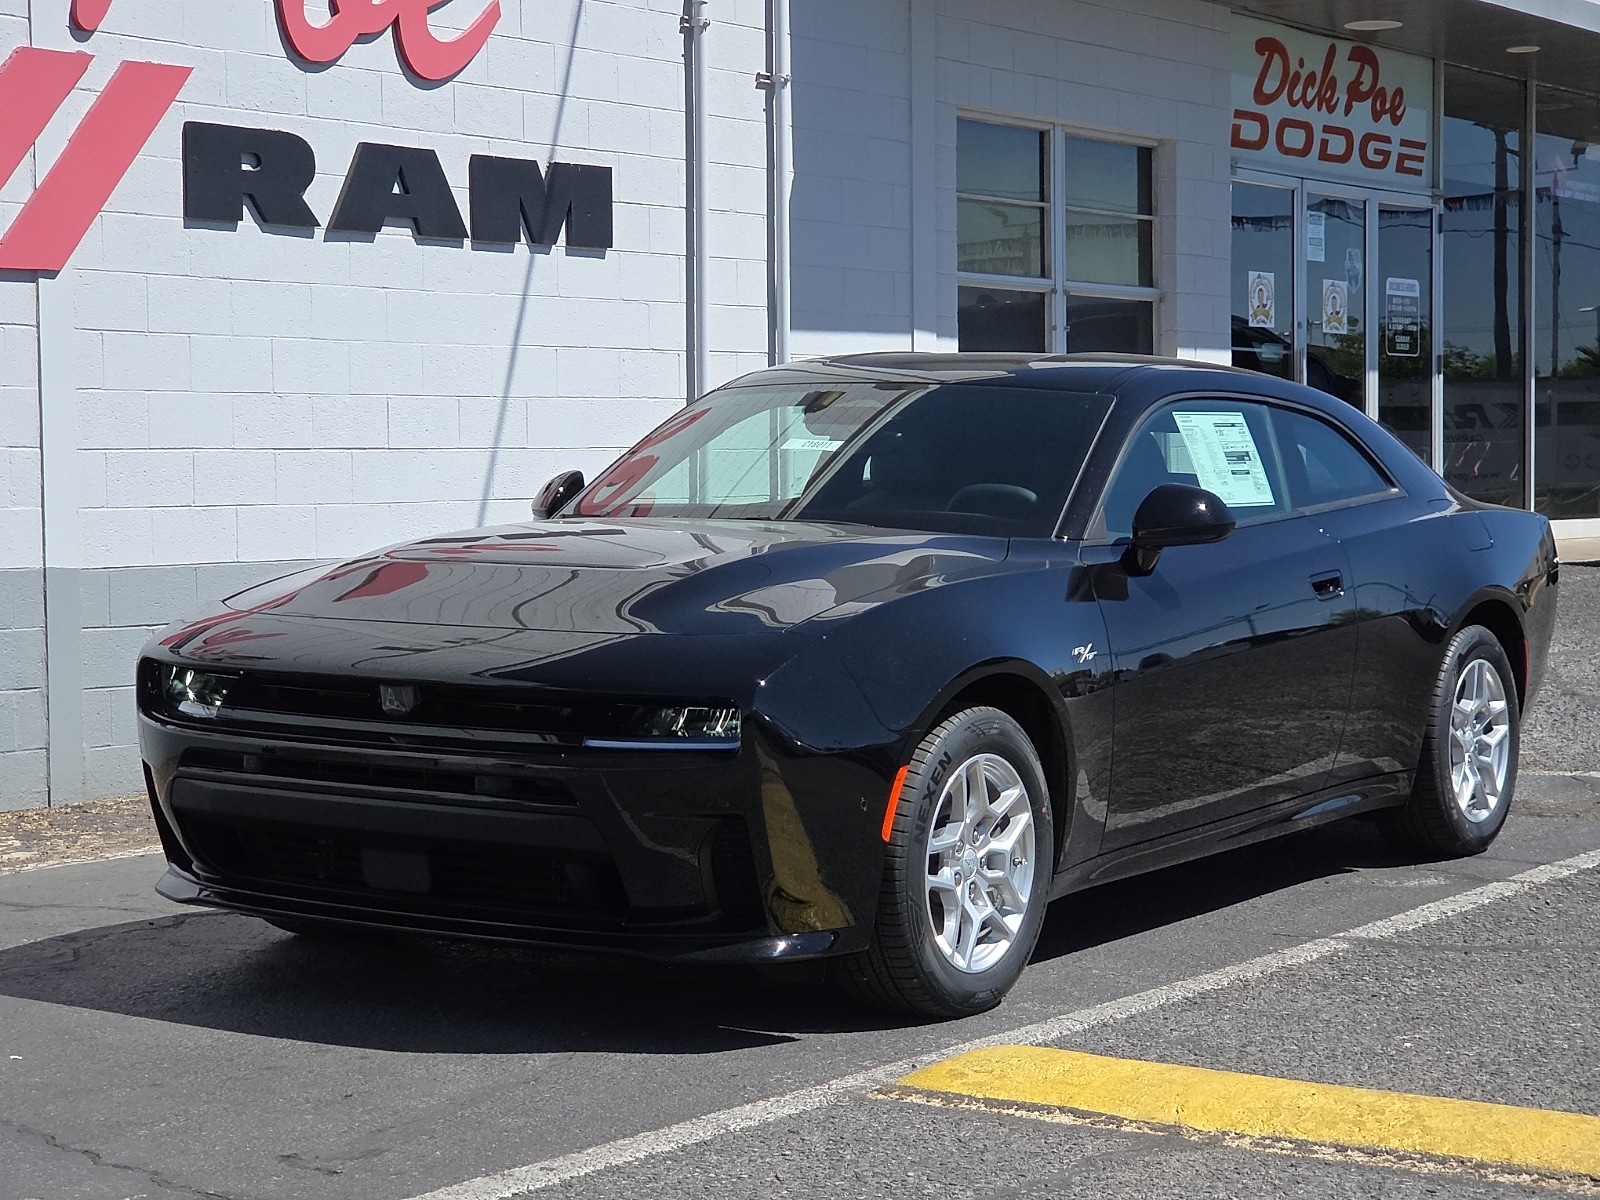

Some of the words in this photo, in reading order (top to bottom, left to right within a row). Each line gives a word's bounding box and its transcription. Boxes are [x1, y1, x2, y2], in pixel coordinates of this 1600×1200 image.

[1253, 36, 1340, 115] Dick
[1344, 45, 1407, 127] Poe
[182, 120, 613, 250] RAM
[1231, 108, 1427, 177] DODGE
[1071, 642, 1098, 664] R/T
[912, 750, 953, 844] NEXEN
